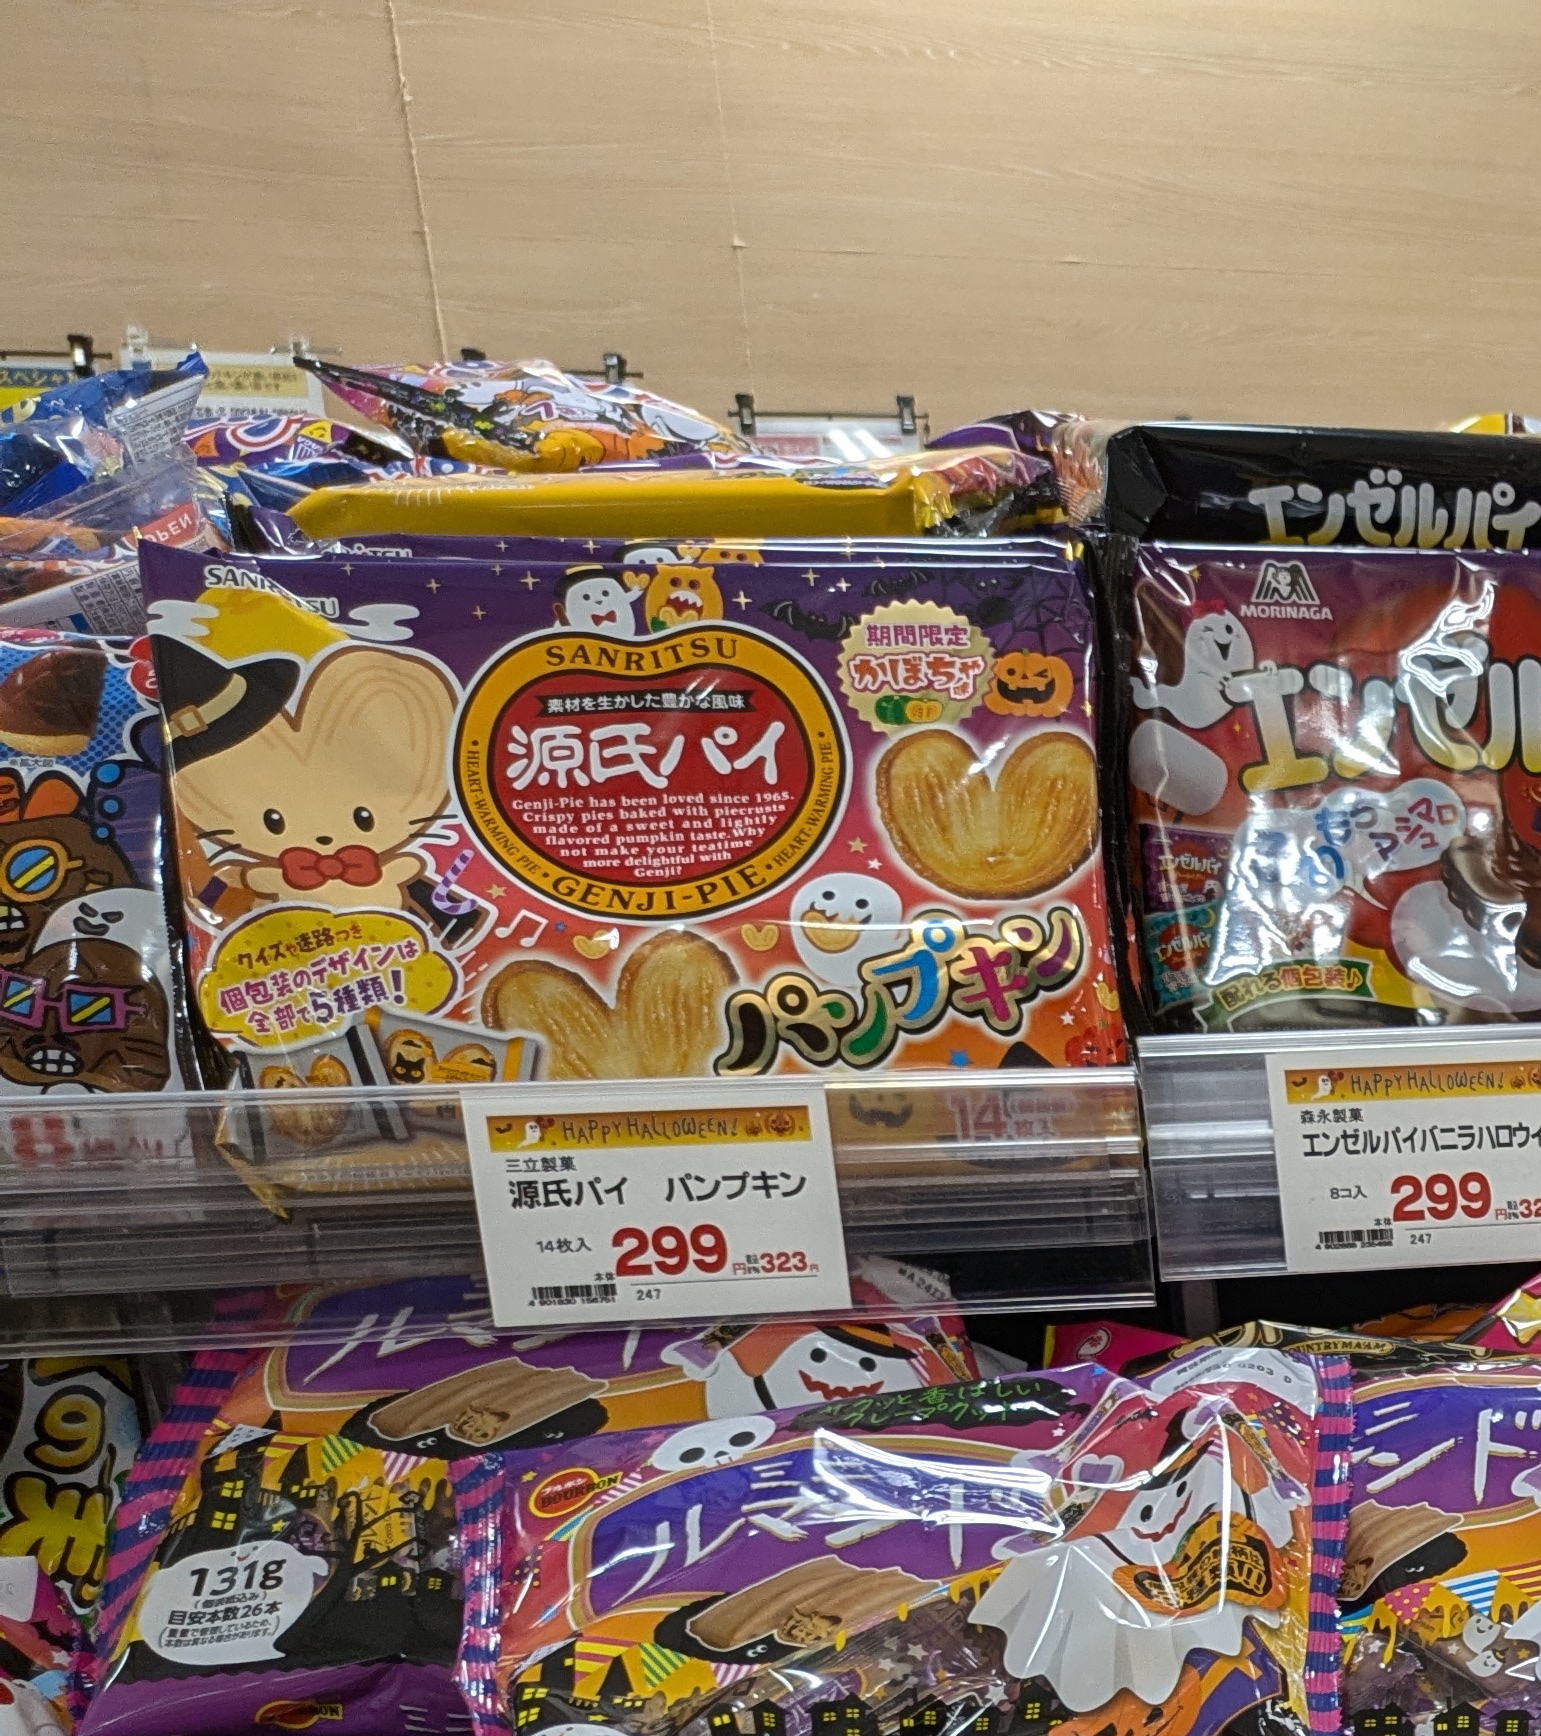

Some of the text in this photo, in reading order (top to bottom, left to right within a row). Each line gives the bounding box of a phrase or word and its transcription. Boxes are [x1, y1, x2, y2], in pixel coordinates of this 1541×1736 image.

[1241, 604, 1333, 622] MORINAGA
[866, 624, 970, 648] 期間限定
[546, 638, 739, 673] SANRITSU
[547, 693, 746, 714] 素材を生かした豊かな風味
[507, 720, 786, 792] 源氏パイ
[512, 797, 584, 810] Genji-Pie
[589, 797, 616, 808] has
[621, 796, 657, 807] been
[662, 793, 704, 805] loved
[710, 794, 749, 804] since
[522, 803, 786, 825] Crispy pies baked with piecrusts
[533, 814, 778, 834] made of a sweet and lightly
[546, 834, 610, 846] flavored
[616, 832, 684, 846] pumpkin
[560, 839, 753, 857] not make your teatime
[582, 851, 731, 868] more delightful with
[552, 860, 769, 914] GENJI-PIE
[237, 925, 363, 970] クイズや迷路つき
[218, 939, 420, 1014] 個包装のデザインは
[722, 909, 1084, 1075] パンプキン
[1351, 1071, 1504, 1096] HAPPY HALLOWEEN!
[1301, 1108, 1363, 1123] 森永製菓
[563, 1114, 738, 1144] HAPPY HALLOWEEN!
[505, 1157, 577, 1173] 三立製菓
[1330, 1186, 1367, 1200] 8コ入
[536, 1238, 592, 1253] 14枚入
[1410, 1233, 1431, 1244] 247
[637, 1289, 660, 1301] 247
[187, 1556, 285, 1600] 131g
